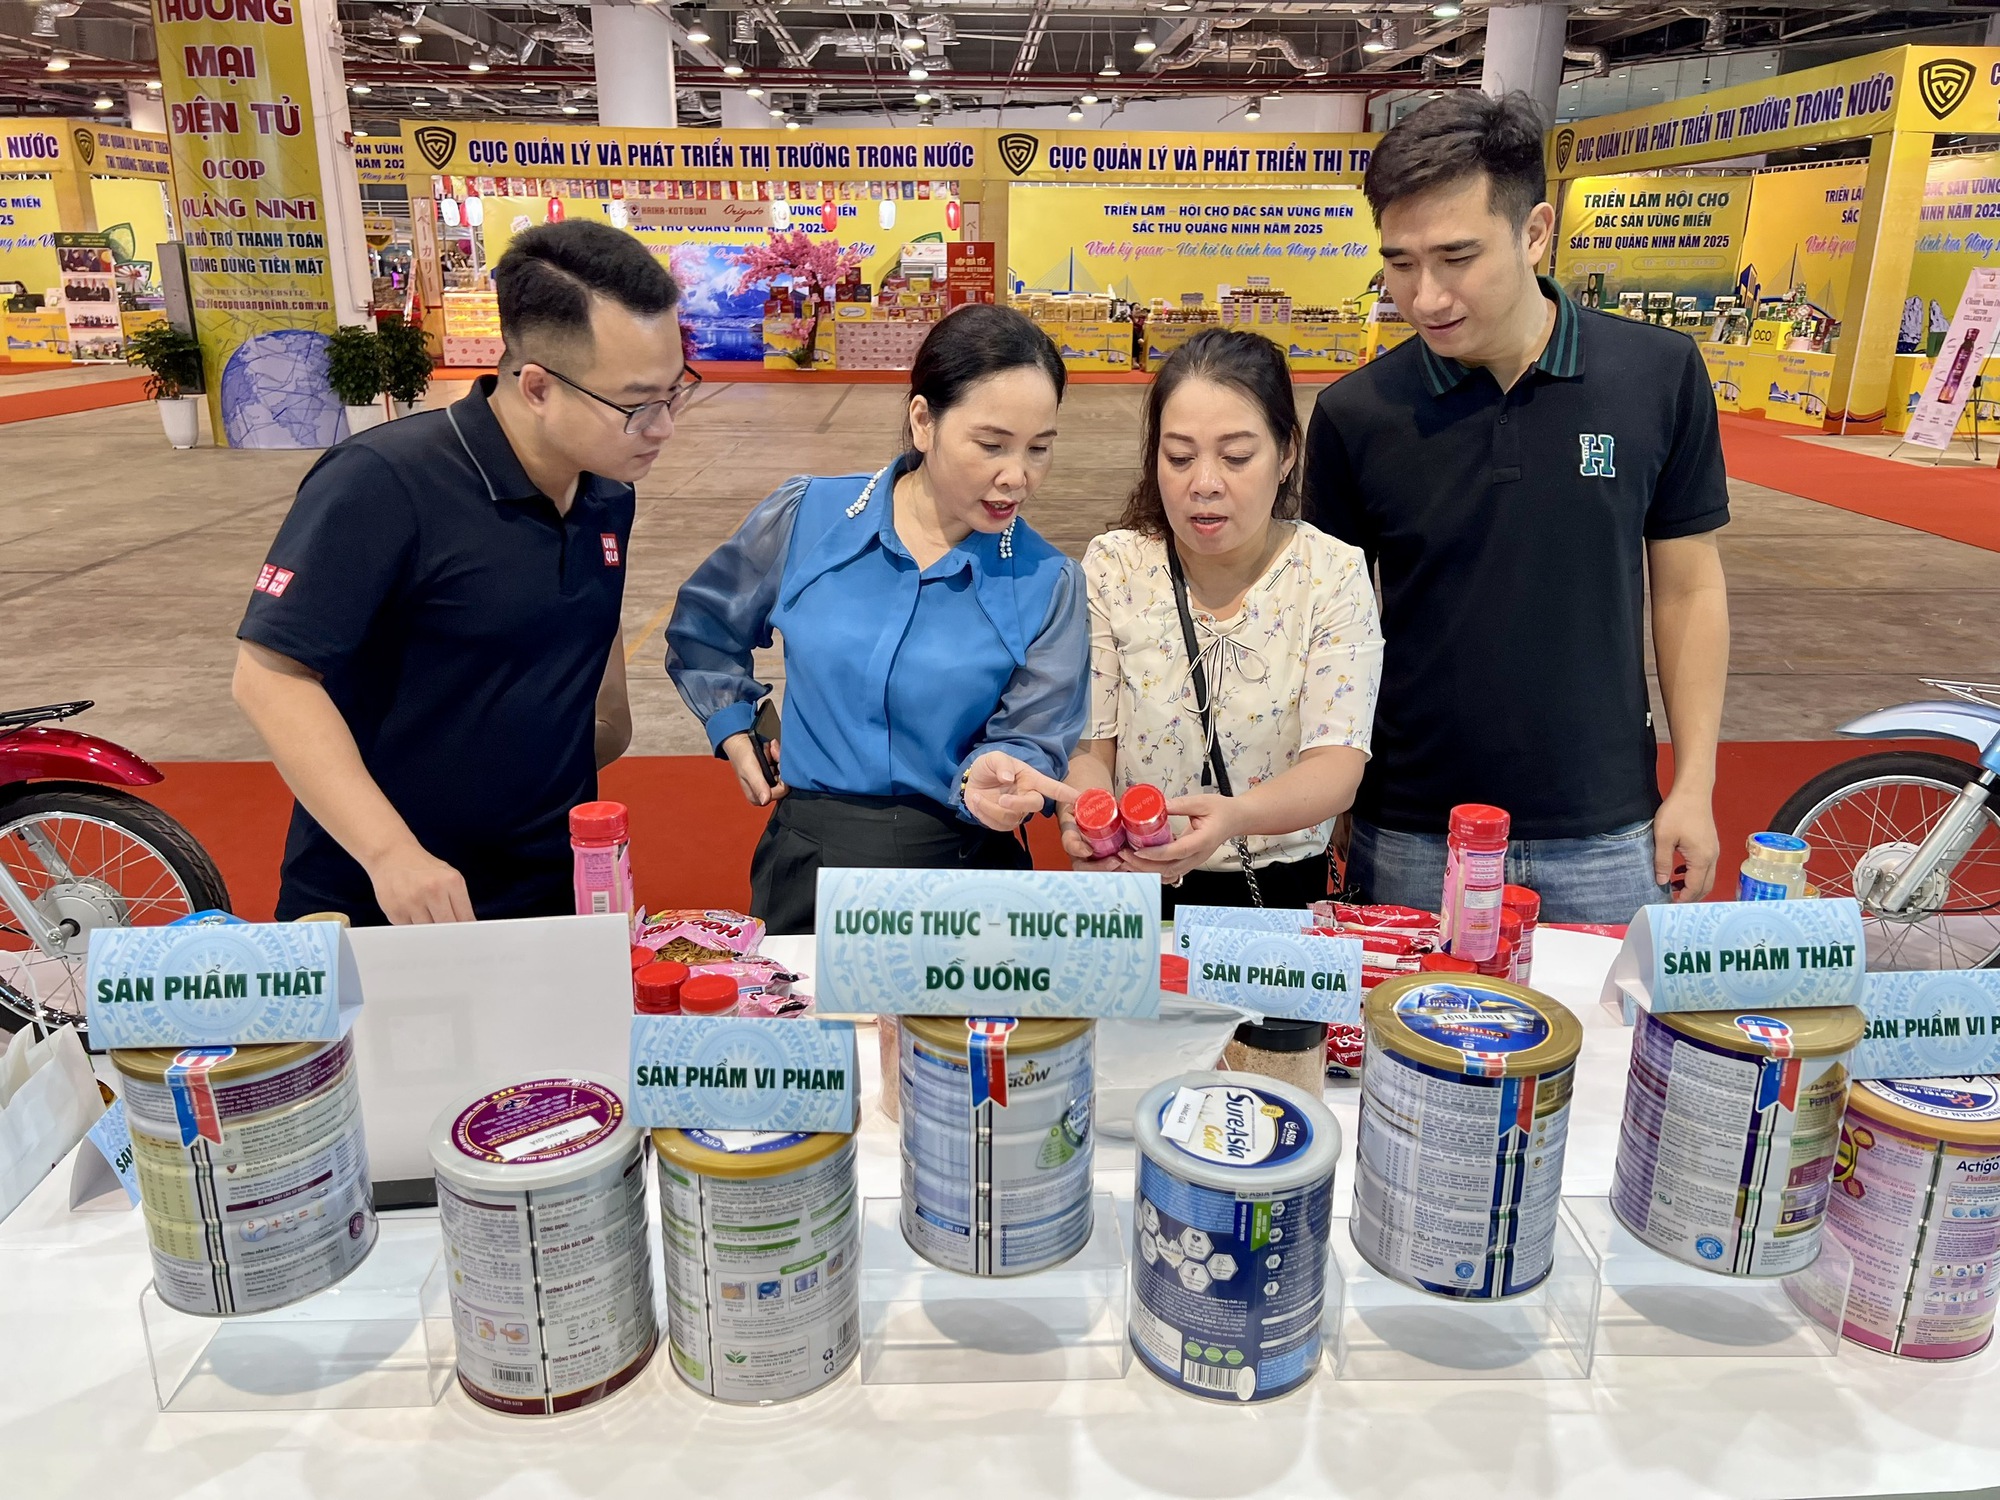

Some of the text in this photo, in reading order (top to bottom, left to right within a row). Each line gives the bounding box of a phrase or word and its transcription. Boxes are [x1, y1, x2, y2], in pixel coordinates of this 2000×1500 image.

[184, 46, 256, 85] MẠI
[172, 96, 301, 141] ĐIỆN TỬ
[1576, 72, 1894, 166] CỤC QUẢN LÝ VÀ PHÁT TRIỂN THỊ TRƯỜNG TRONG NƯỚC
[7, 133, 59, 159] NƯỚC
[469, 137, 974, 172] CỤC QUẢN LÝ VÀ PHÁT TRIỂN THỊ TRƯỜNG TRONG NƯỚC
[1050, 146, 1087, 173] CỤC
[1094, 142, 1142, 172] QUẢN
[1149, 145, 1169, 171] LÝ
[1174, 145, 1198, 171] VÀ
[1203, 146, 1250, 172] PHÁT
[1256, 142, 1307, 172] TRIỂN
[1313, 149, 1342, 176] THỊ
[202, 160, 266, 180] OCOP
[182, 193, 317, 221] QUẢNG NINH
[1584, 188, 1731, 209] TRIỂN LÃM HỘI CHỢ
[1825, 183, 1850, 203] TRIỂN
[1179, 203, 1201, 218] HỘI
[1204, 204, 1230, 218] CHỢ
[1233, 204, 1257, 219] ĐẶC
[1260, 203, 1283, 217] SẢN
[1287, 204, 1321, 217] VÙNG
[1324, 203, 1354, 217] MIỀN
[1594, 210, 1712, 230] ĐẶC SẢN VÙNG MIỀN
[1920, 202, 2000, 221] NINH NĂM 2025
[210, 231, 324, 249] TRỢ THANH TOÁN
[1132, 220, 1323, 234] SẮC THU QUẢNG NINH NĂM 2025
[1570, 232, 1730, 250] SẮC THU QUẢNG NINH NĂM 2025
[220, 256, 256, 273] DÙNG
[260, 254, 291, 274] TIỀN
[295, 256, 324, 277] MẶT
[417, 213, 436, 293] ベーカリー
[1135, 245, 1165, 261] quan
[1262, 243, 1283, 257] hoa
[1579, 434, 1616, 478] H
[602, 537, 616, 550] UNI
[605, 550, 620, 564] QLO
[835, 903, 1143, 941] LƯƠNG THỰC THỰC PHẨM
[1664, 938, 1856, 976] SẢN PHẨM THẬT
[97, 963, 327, 1004] SẢN PHẨM THẬT
[926, 957, 1051, 991] ĐỒ UỐNG
[1202, 958, 1347, 992] SẢN PHẨM GIẢ
[1864, 1008, 1986, 1040] SẢN PHẨM VI
[637, 1058, 845, 1093] SẢN PHẨM VI PHẠM
[1892, 1096, 1927, 1112] QUAN
[1226, 1090, 1254, 1160] SureAsia
[1284, 1128, 1299, 1146] ASIA
[1203, 1124, 1224, 1155] Gold
